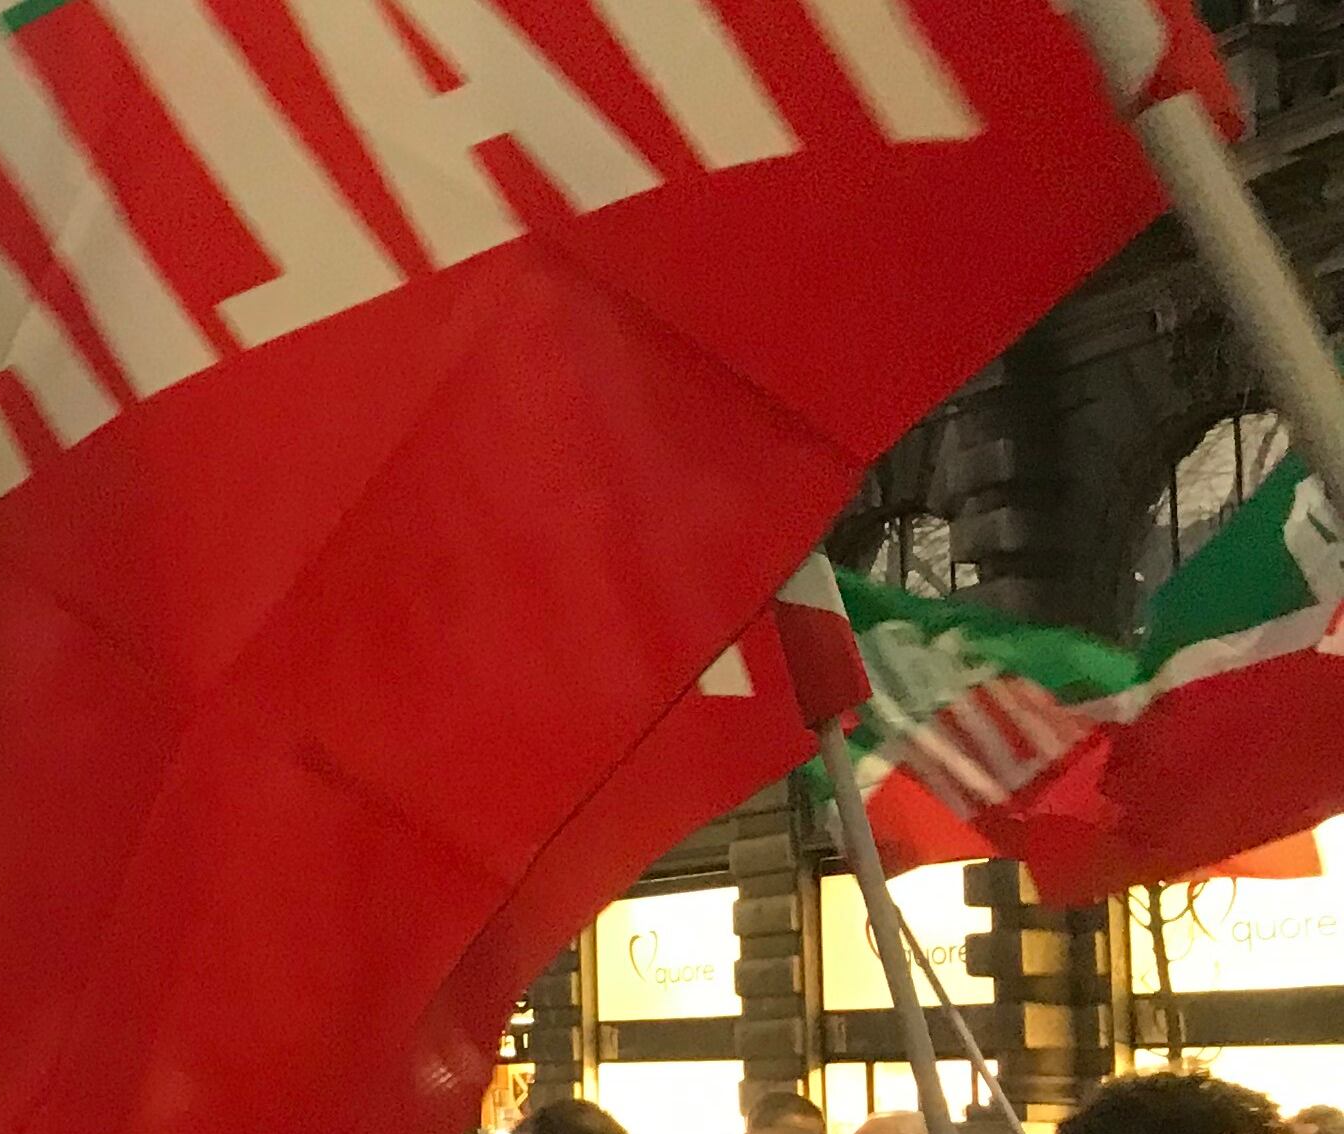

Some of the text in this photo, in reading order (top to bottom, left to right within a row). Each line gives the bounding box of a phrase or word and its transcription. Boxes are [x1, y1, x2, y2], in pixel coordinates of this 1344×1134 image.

[1231, 913, 1338, 952] quore
[904, 944, 967, 976] ore
[655, 964, 715, 992] quore
